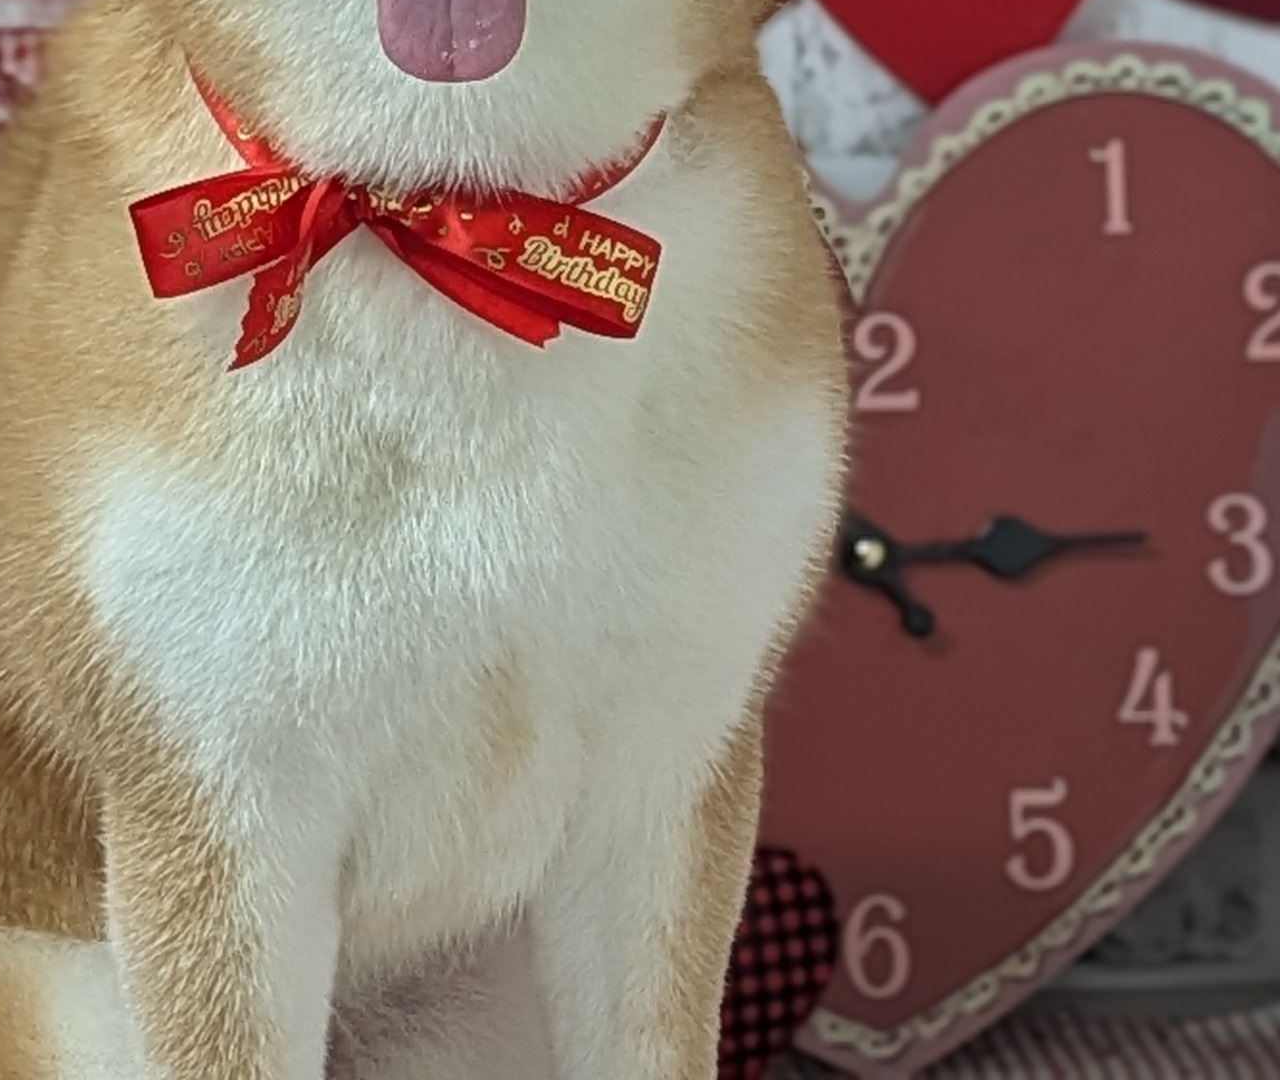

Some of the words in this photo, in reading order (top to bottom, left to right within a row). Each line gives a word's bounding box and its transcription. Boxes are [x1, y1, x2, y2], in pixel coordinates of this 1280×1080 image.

[1089, 139, 1132, 236] 1
[517, 236, 648, 323] Birthday
[578, 230, 654, 279] HAPPY
[1206, 494, 1273, 595] 3
[1117, 649, 1188, 746] 4
[1004, 778, 1075, 890] 5
[842, 894, 910, 997] 6
